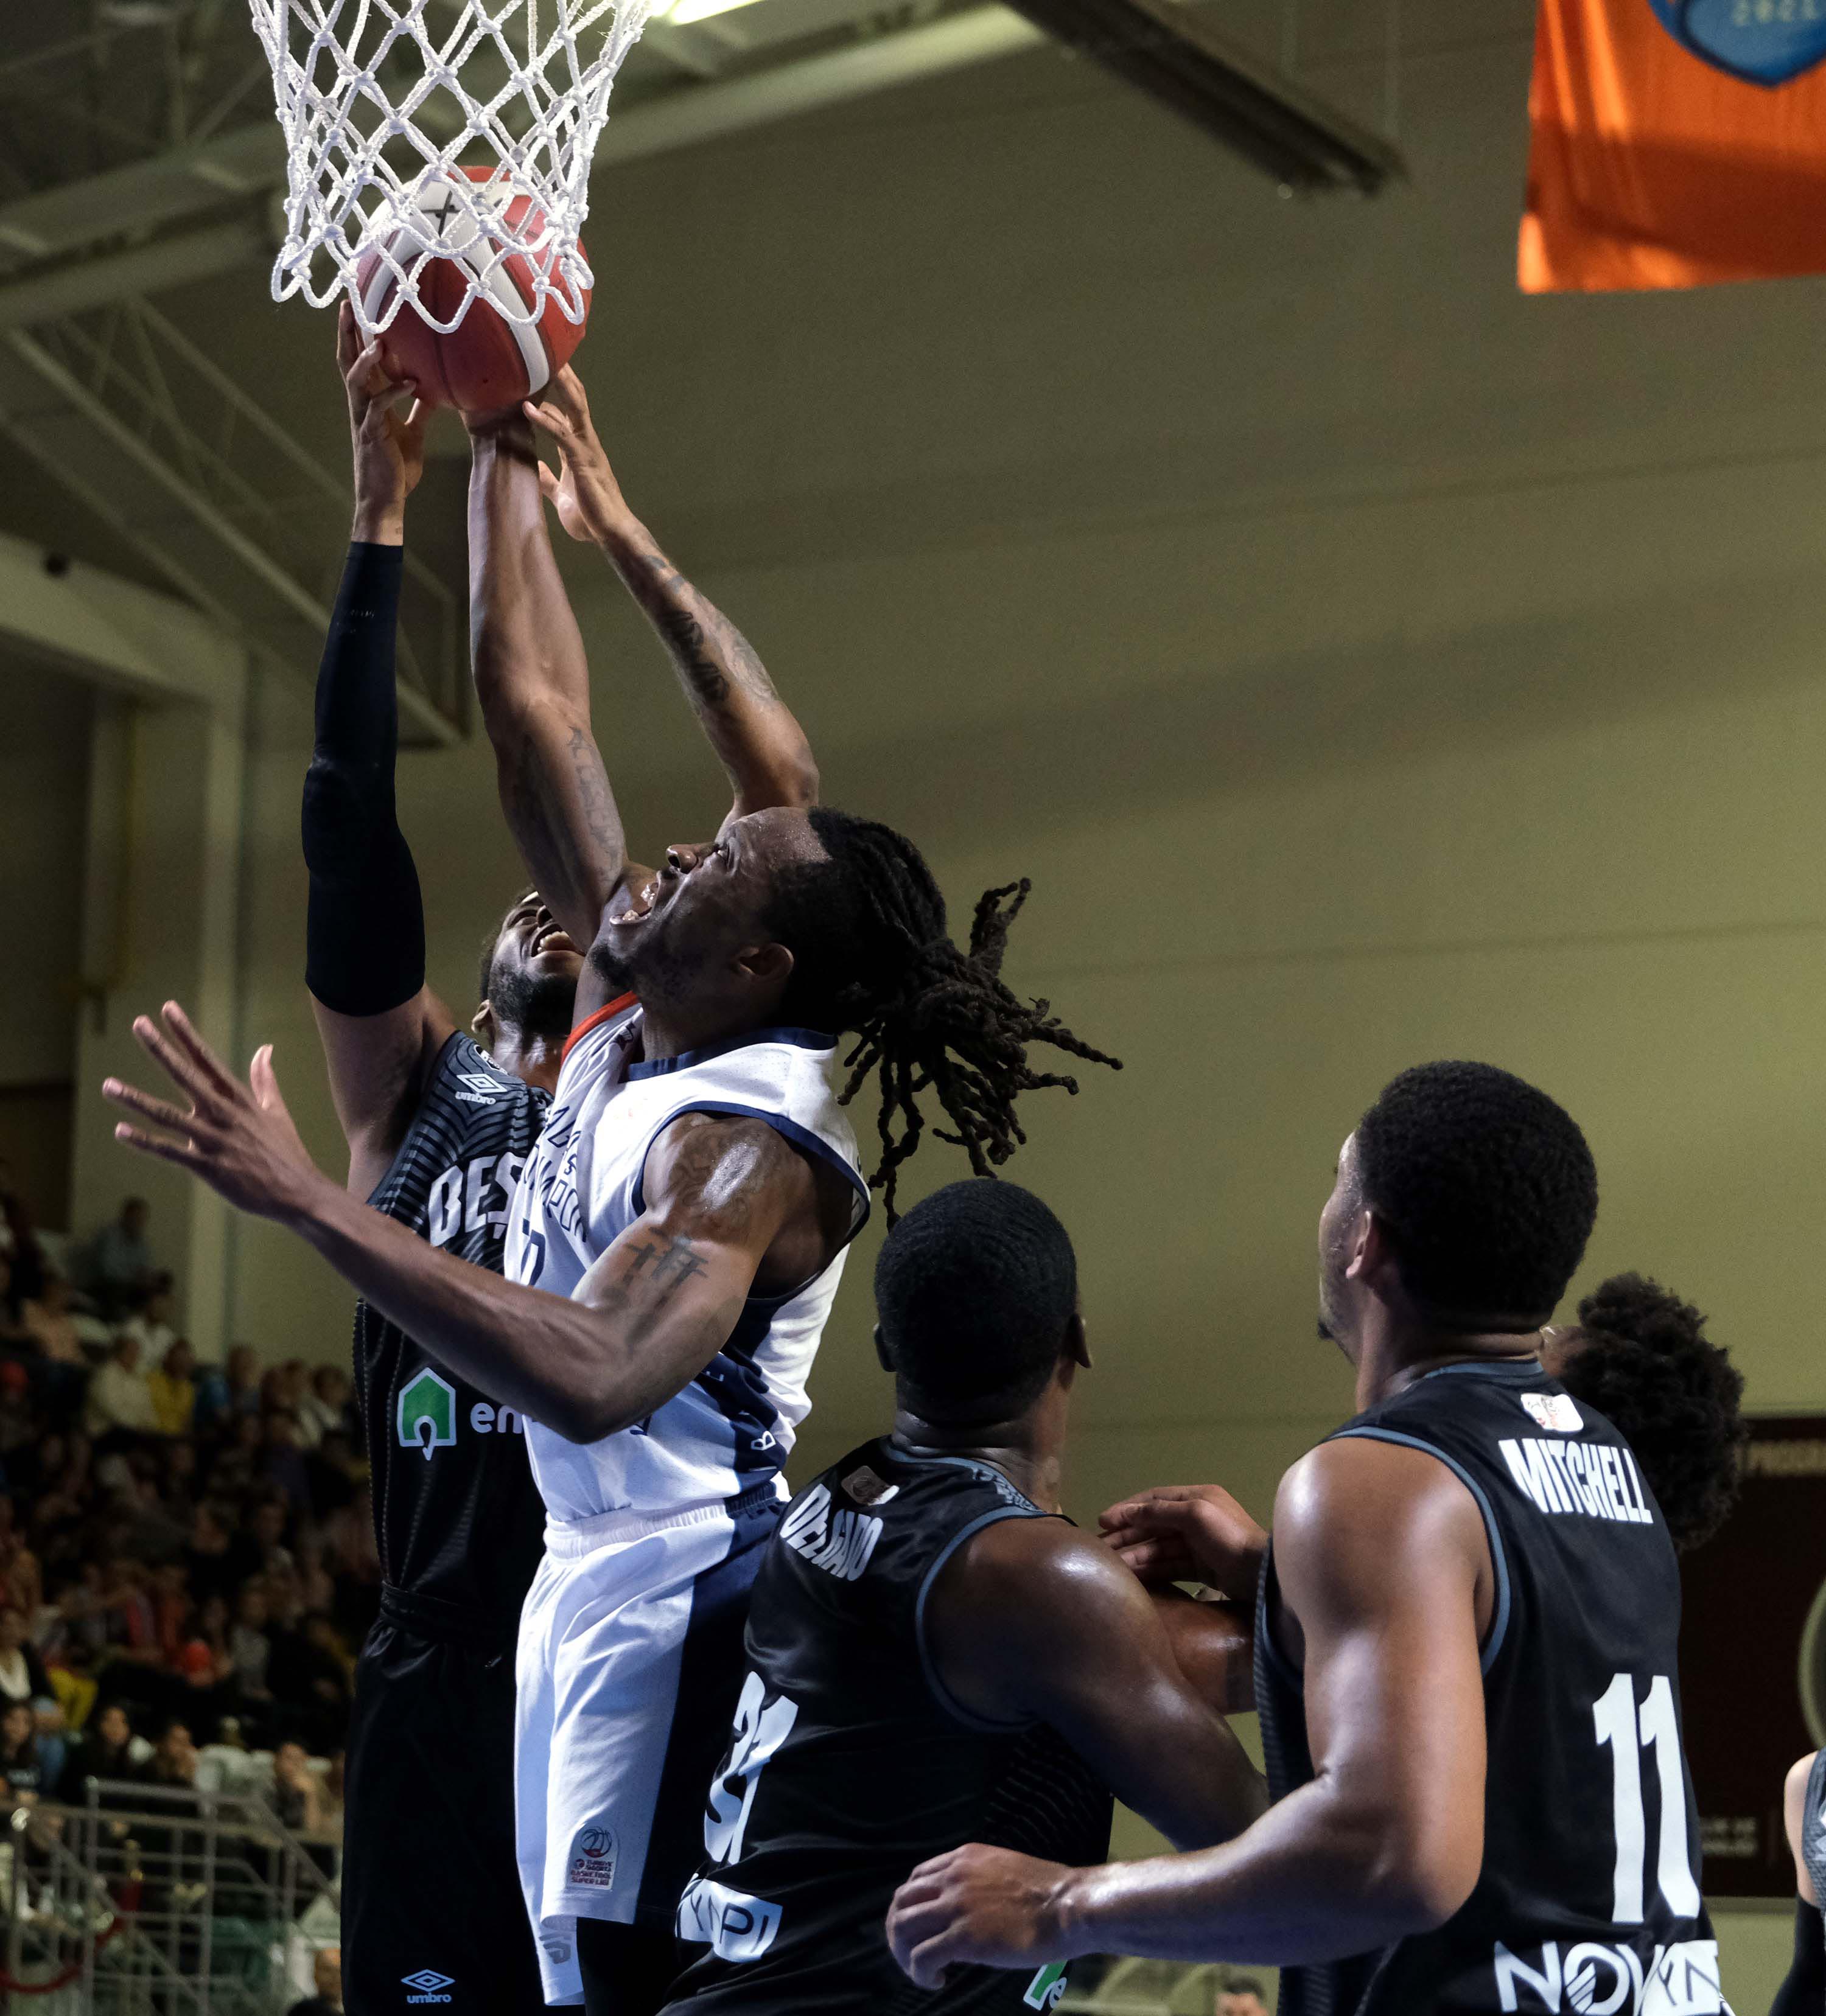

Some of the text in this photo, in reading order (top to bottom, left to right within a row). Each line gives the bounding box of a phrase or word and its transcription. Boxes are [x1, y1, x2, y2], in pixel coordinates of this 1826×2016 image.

[455, 1091, 496, 1105] umbro
[1498, 1438, 1654, 1524] MITCHELL
[780, 1484, 883, 1582] DELGADO
[1592, 1673, 1701, 1923] 11
[407, 1992, 452, 2003] umbro
